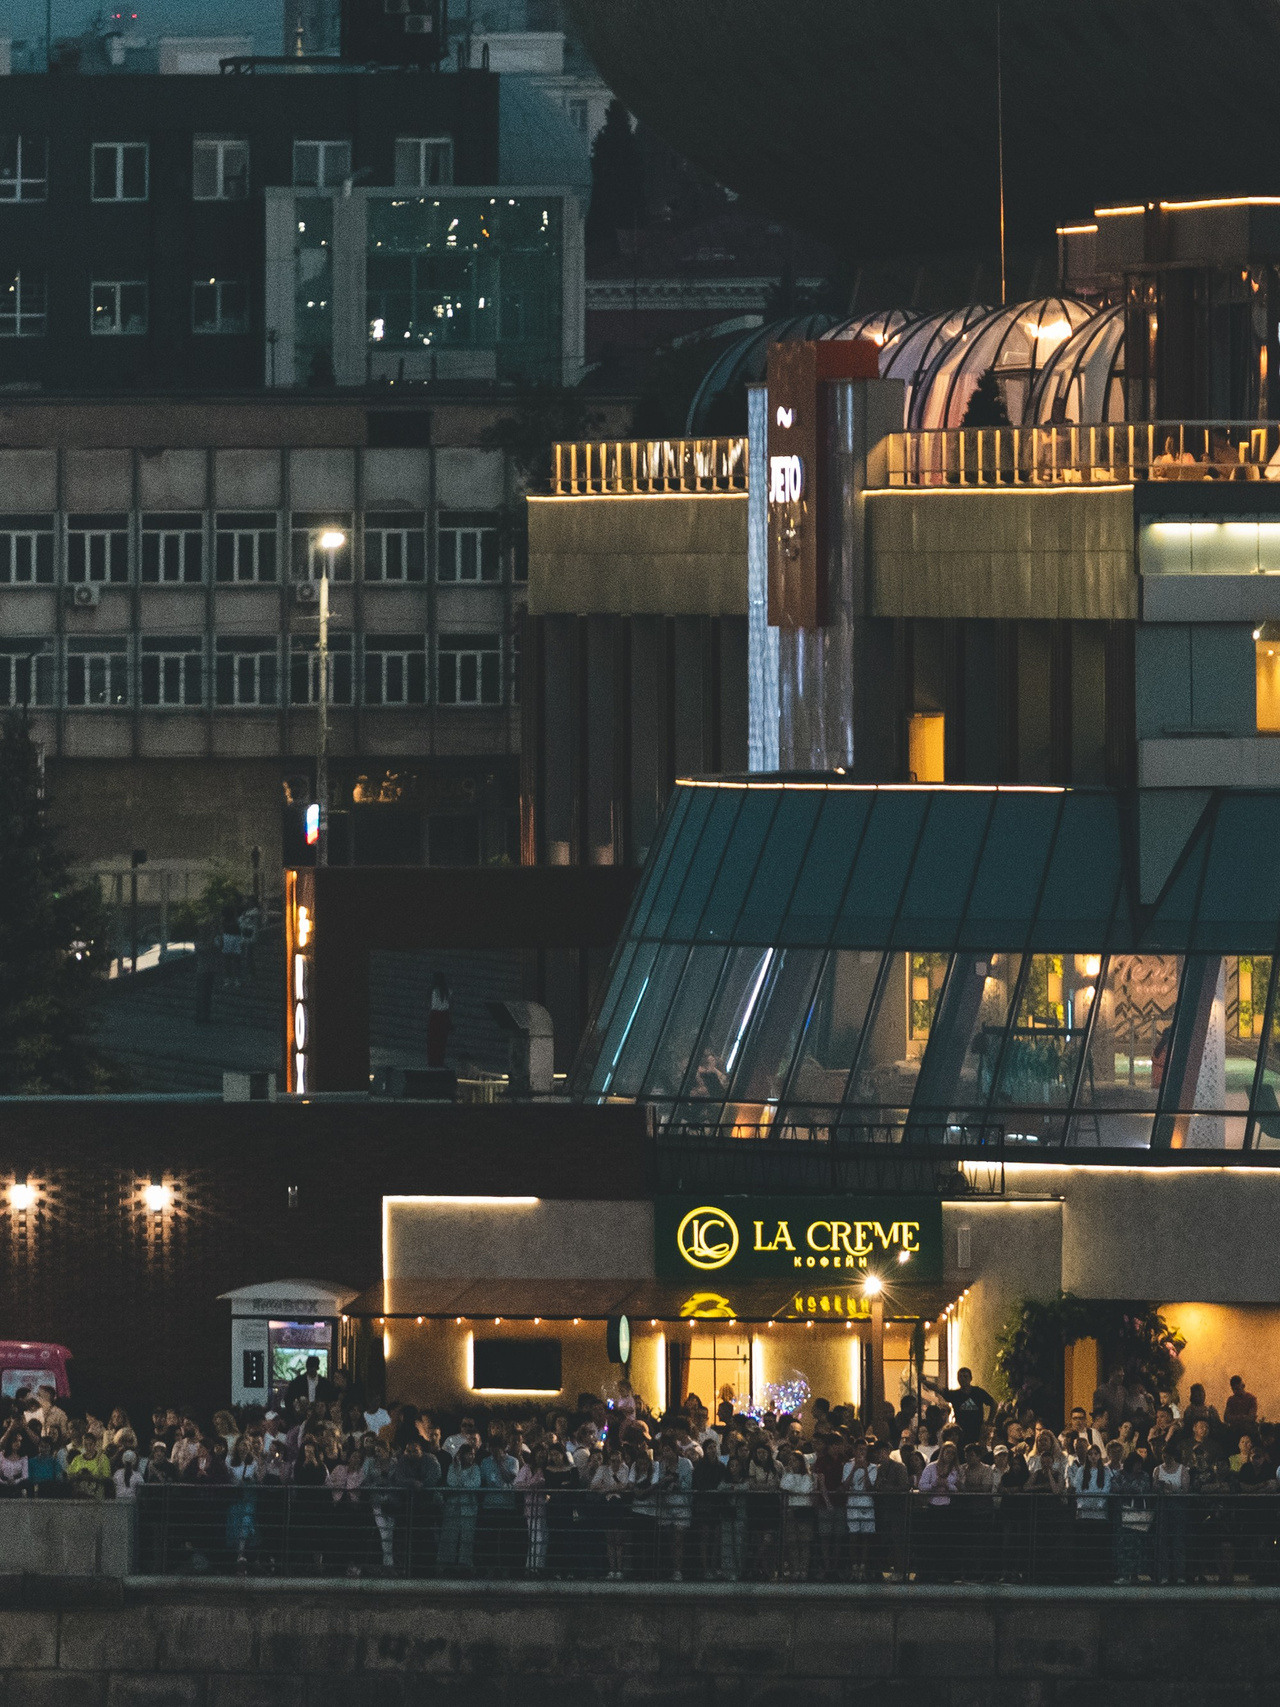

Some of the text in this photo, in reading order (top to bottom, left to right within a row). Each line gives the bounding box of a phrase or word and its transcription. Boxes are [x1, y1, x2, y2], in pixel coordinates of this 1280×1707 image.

[753, 1221, 920, 1257] LA CREME
[793, 1254, 868, 1268] КОФЕЙН
